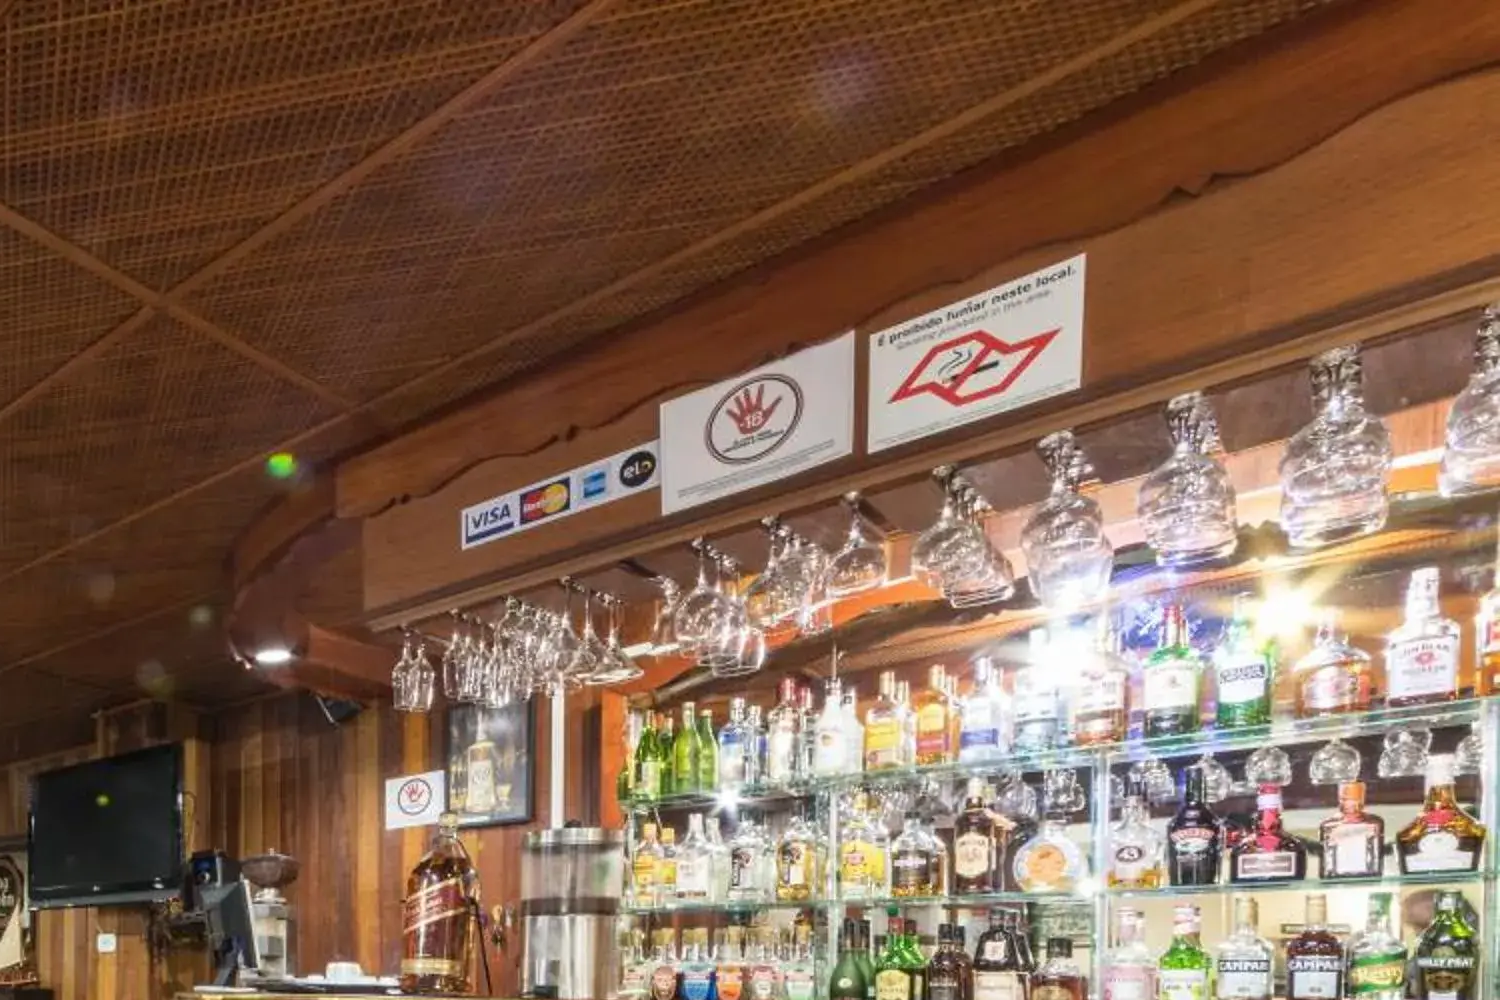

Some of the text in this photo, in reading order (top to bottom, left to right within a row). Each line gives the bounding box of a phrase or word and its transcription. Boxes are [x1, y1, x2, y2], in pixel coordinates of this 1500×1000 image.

[889, 316, 943, 345] proibido
[947, 301, 987, 321] fumar
[992, 282, 1032, 304] neste
[471, 503, 512, 530] VISA
